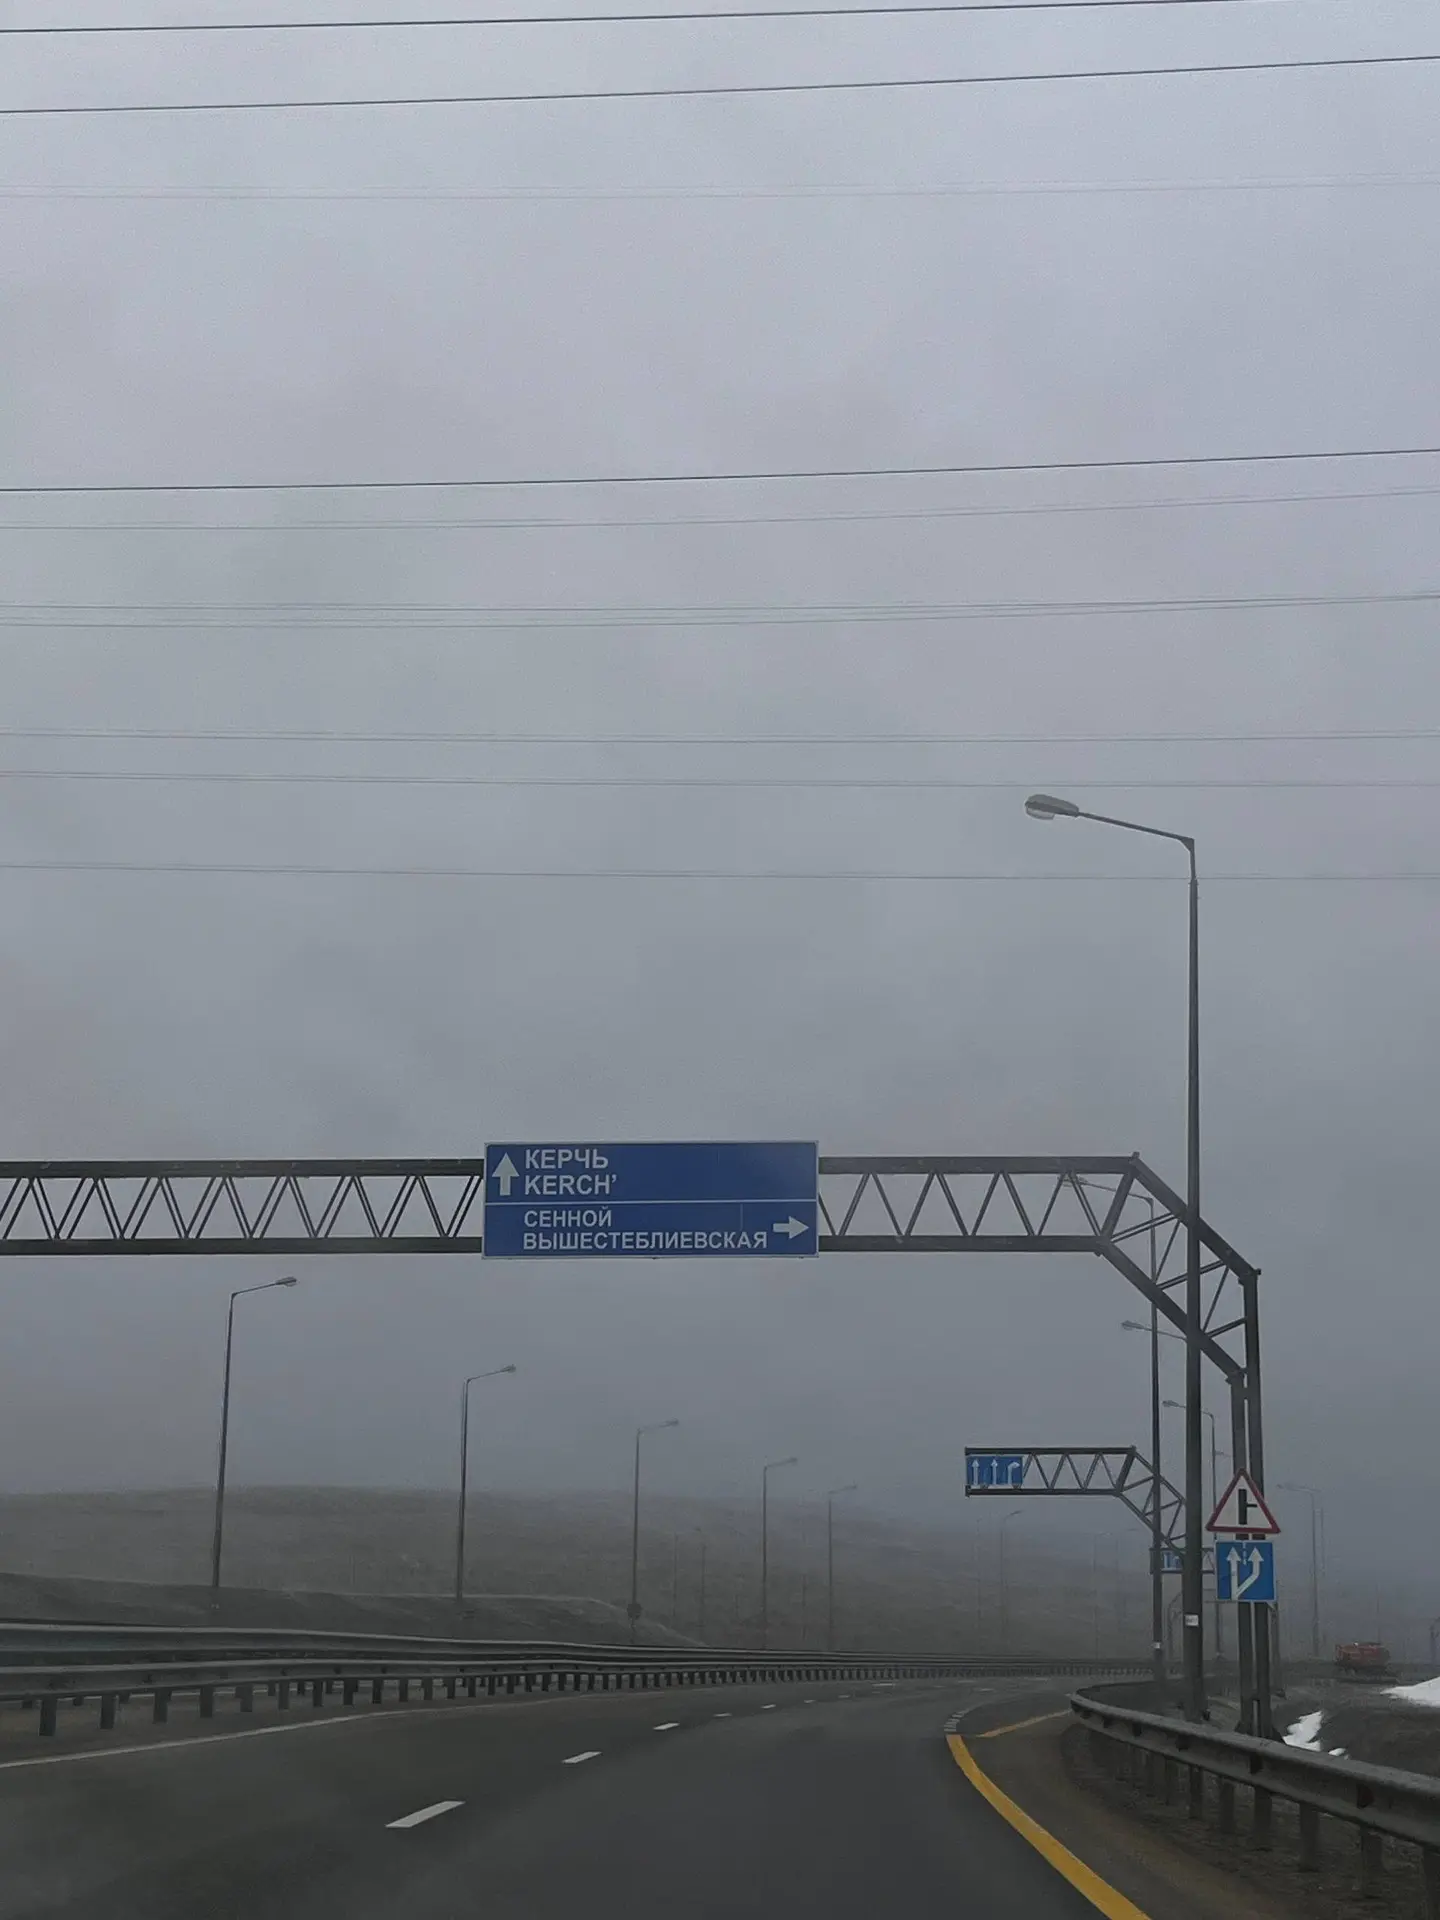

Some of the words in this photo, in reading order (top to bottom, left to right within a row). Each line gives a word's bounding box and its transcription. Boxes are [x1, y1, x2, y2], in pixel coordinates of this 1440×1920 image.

[525, 1148, 609, 1169] КЕРЧЬ
[524, 1206, 612, 1228] СЕННОЙ
[523, 1231, 767, 1250] ВЫШЕСТЕБЛИЕВСКАЯ
